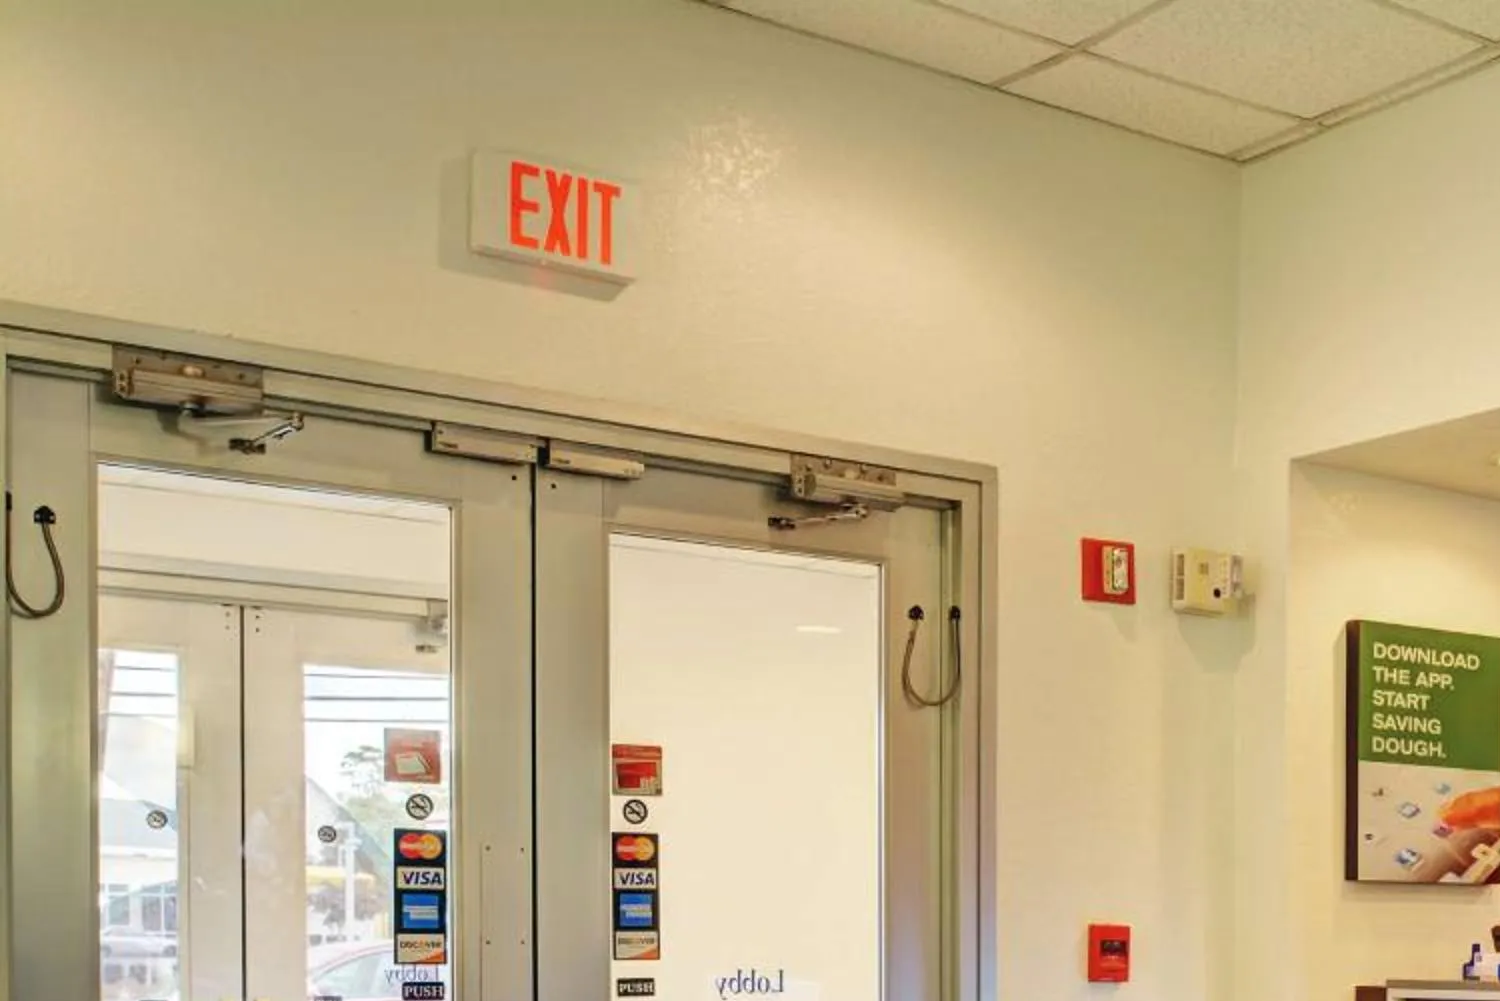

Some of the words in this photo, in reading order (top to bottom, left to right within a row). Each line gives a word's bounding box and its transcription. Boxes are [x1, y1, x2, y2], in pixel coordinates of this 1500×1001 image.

[510, 161, 622, 266] EXIT
[1372, 641, 1481, 671] DOWNLOAD
[1372, 665, 1411, 685] THE
[1415, 671, 1455, 691] APP.
[1372, 689, 1431, 711] START
[1372, 712, 1442, 735] SAVING
[1371, 736, 1447, 758] DOUGH.
[402, 870, 443, 886] VISA
[619, 871, 655, 886] VISA
[403, 985, 443, 998] PUSH
[618, 982, 655, 994] PUSH
